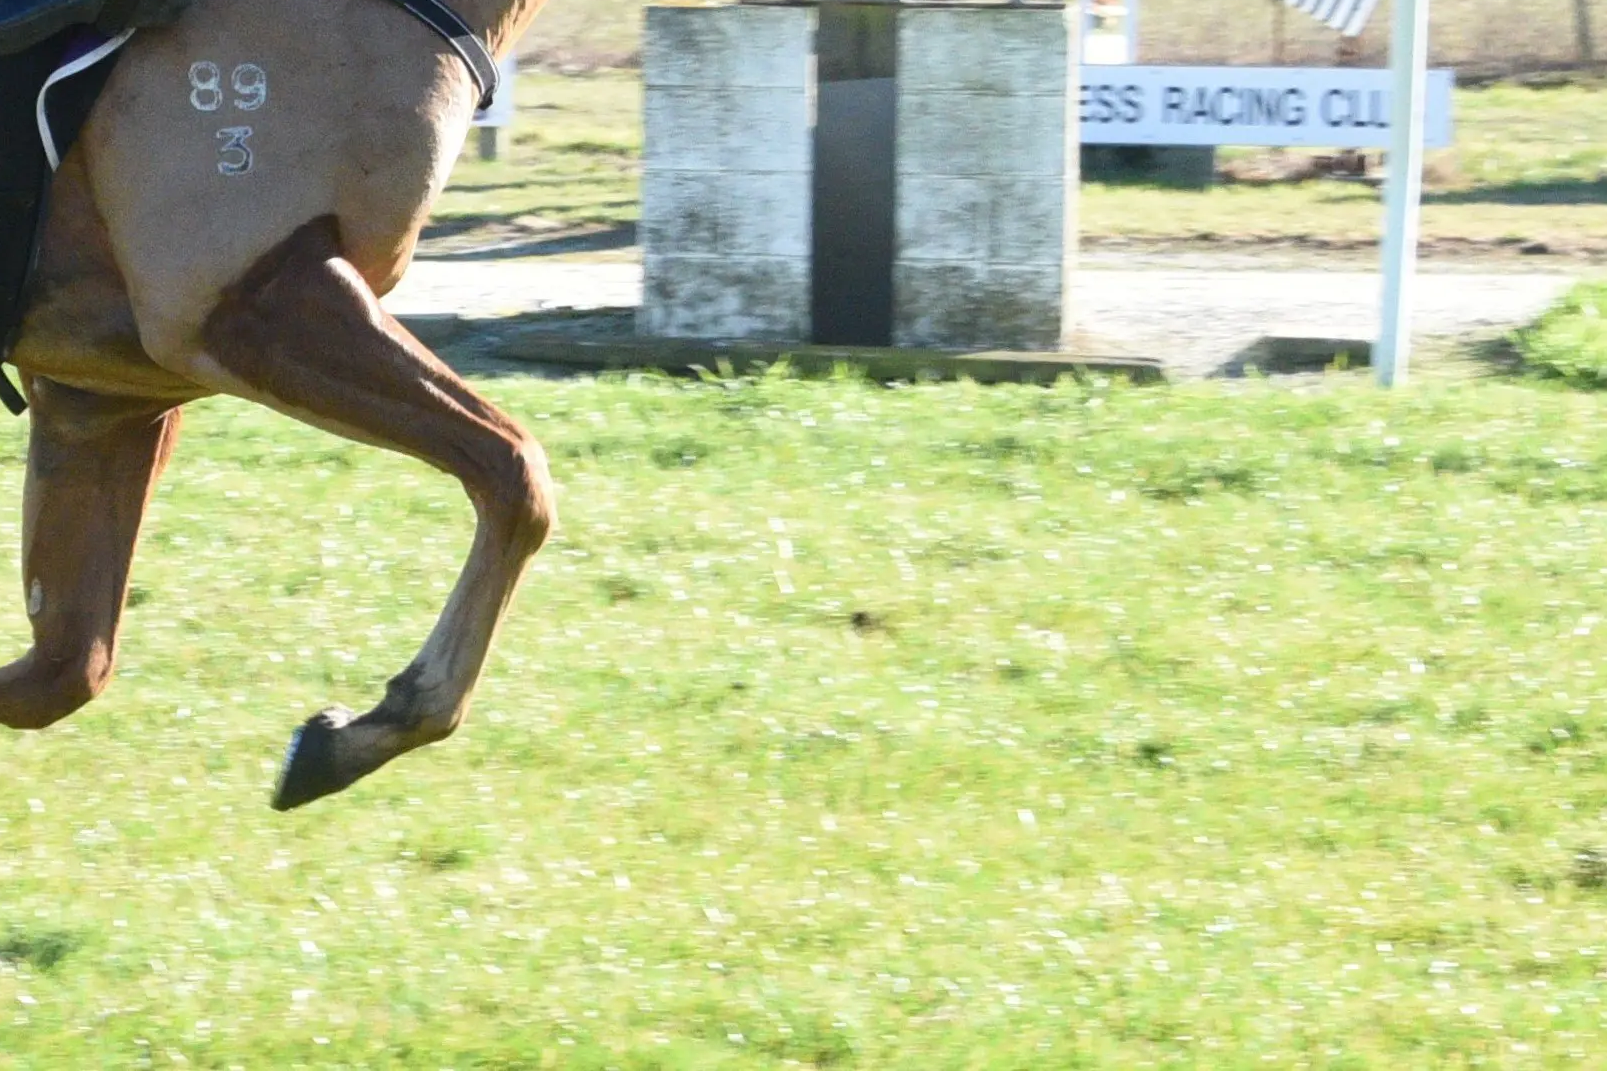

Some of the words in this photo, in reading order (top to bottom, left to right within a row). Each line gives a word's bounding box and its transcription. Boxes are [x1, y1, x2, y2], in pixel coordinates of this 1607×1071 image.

[188, 60, 267, 111] 89
[1160, 84, 1307, 128] RACING
[1321, 86, 1393, 129] CLU
[216, 126, 254, 175] 3
